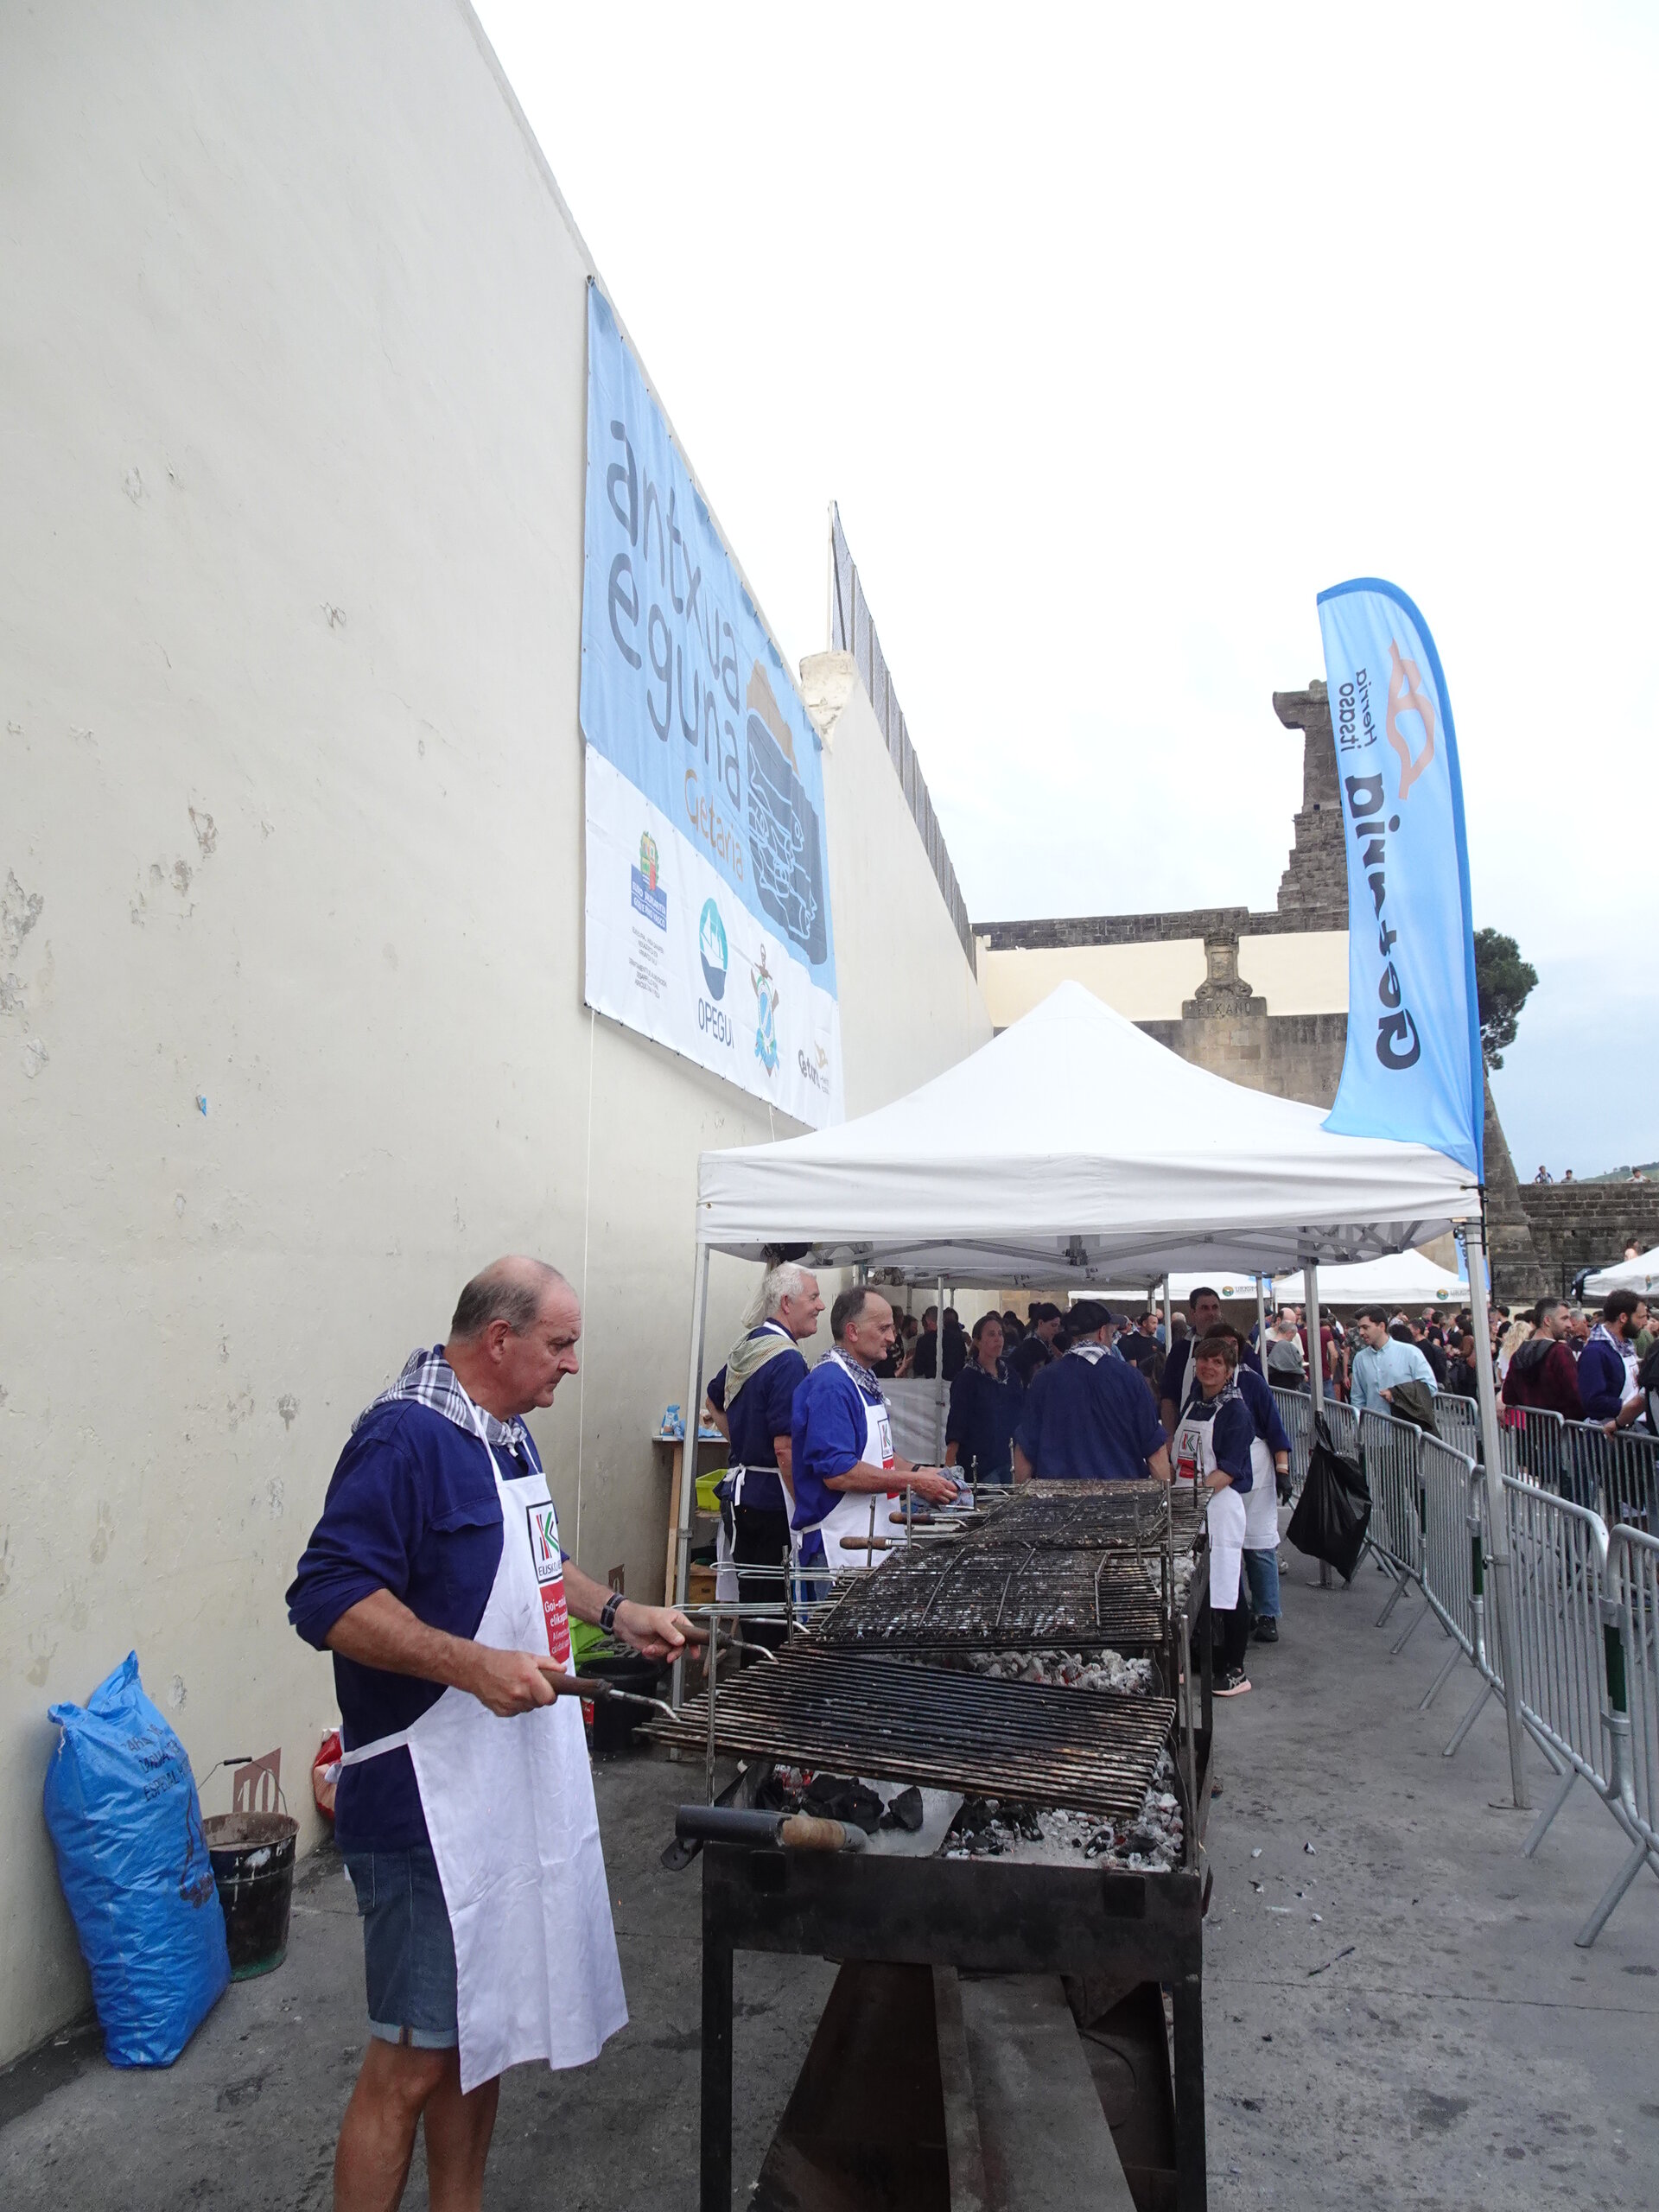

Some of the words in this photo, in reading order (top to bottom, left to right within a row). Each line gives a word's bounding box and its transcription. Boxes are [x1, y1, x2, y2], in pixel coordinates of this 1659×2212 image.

[607, 420, 740, 716] antxua
[608, 552, 741, 812] eguna
[684, 768, 744, 883] Getaria
